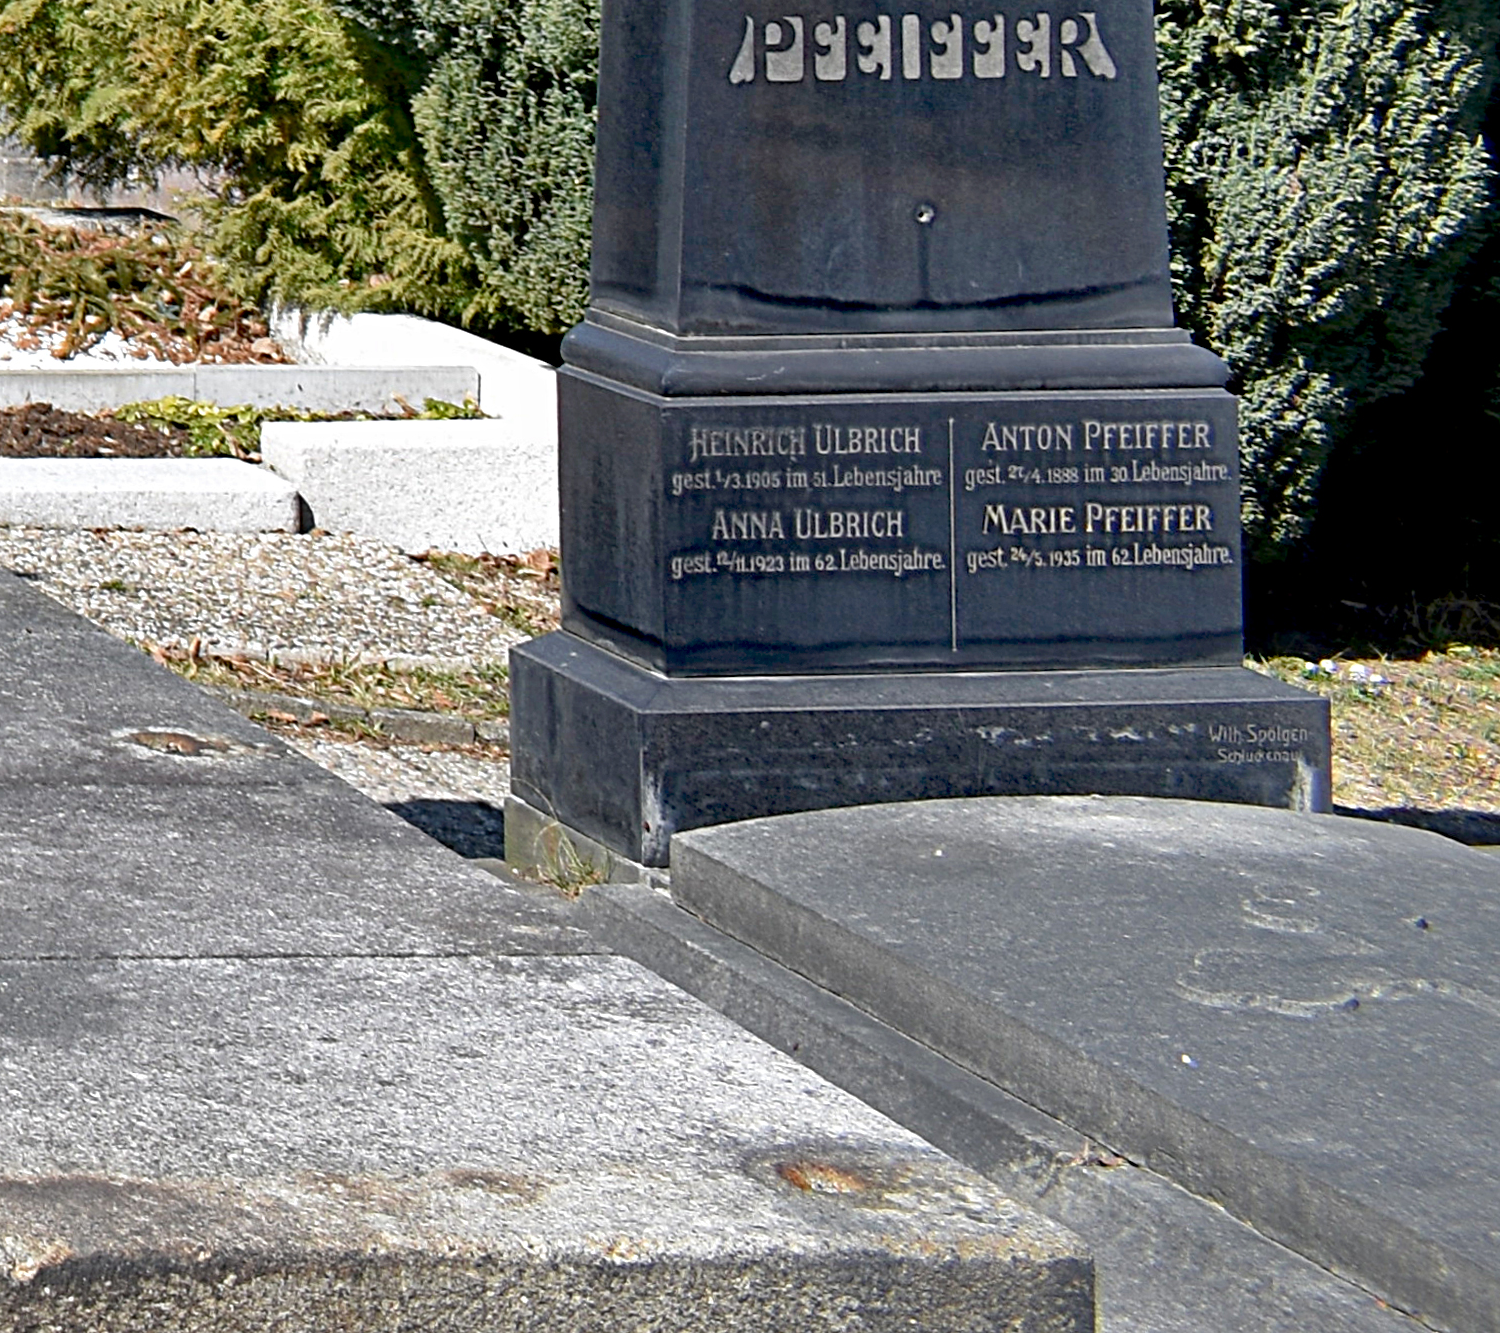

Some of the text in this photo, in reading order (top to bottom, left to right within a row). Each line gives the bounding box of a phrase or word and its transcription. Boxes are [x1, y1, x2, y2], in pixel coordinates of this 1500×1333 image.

[729, 12, 1117, 85] PFEIFFER
[690, 423, 922, 463] HEINRICH ULBRICH
[981, 419, 1212, 452] ANTON PFEIFFER
[785, 467, 809, 489] im
[1083, 462, 1105, 484] im
[711, 507, 904, 541] ANNA ULBRICH
[981, 502, 1213, 536] MARIE PFEIFFER
[789, 551, 811, 572] im
[1085, 543, 1108, 567] im
